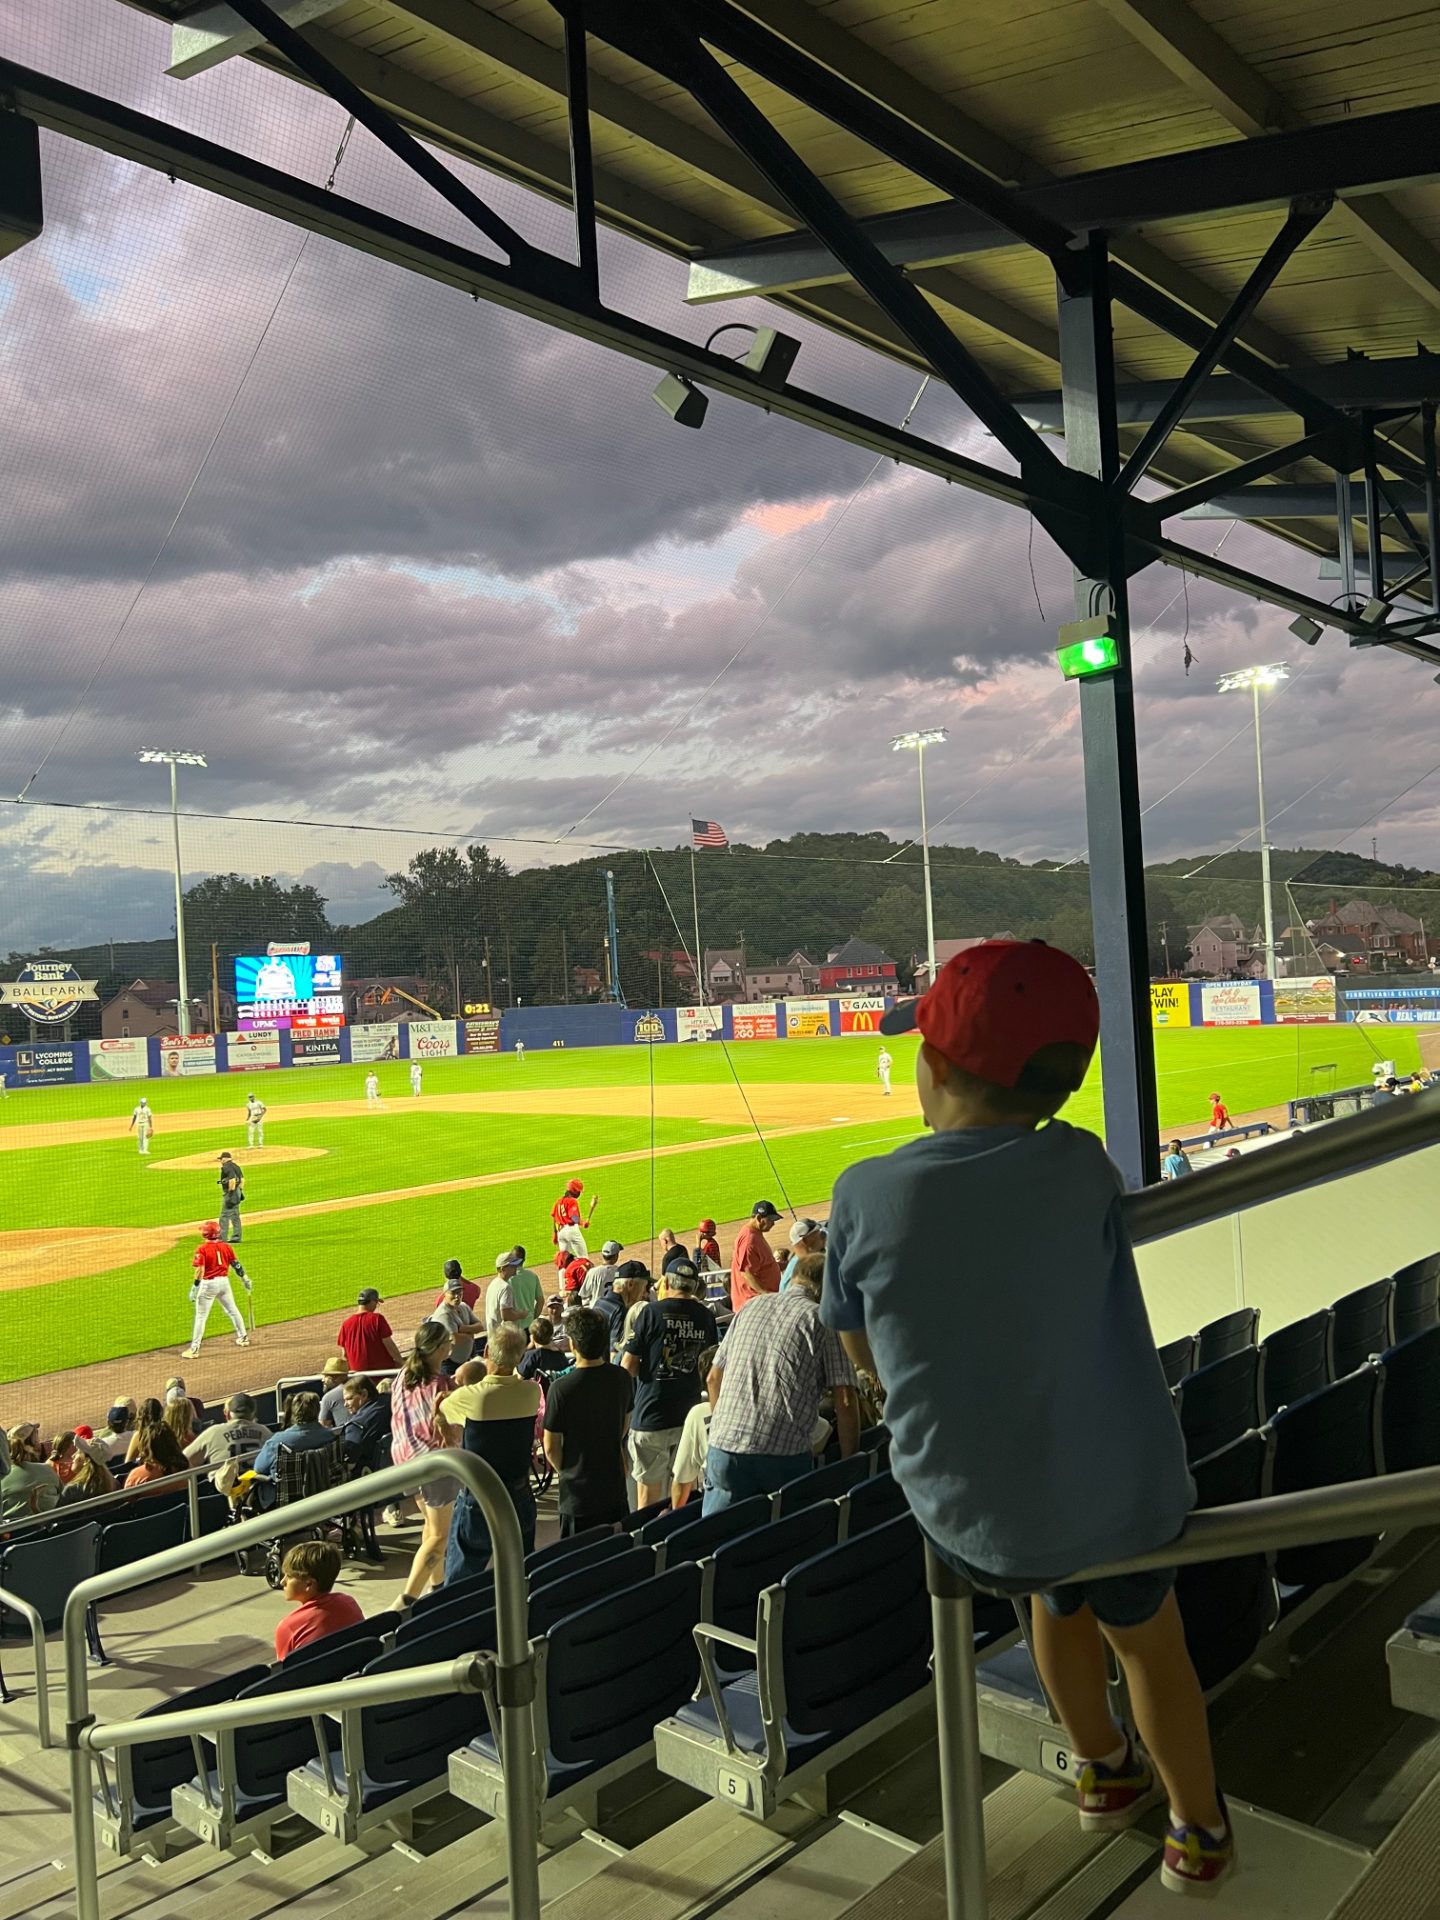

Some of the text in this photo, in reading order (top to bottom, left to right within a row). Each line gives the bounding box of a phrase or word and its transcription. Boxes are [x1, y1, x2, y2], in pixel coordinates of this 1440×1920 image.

[25, 963, 72, 973] Journey
[33, 971, 65, 981] Bank
[12, 985, 86, 997] BALLPARK
[852, 1001, 883, 1010] GAVL
[1154, 998, 1179, 1008] WIN!
[464, 1003, 490, 1014] 0:21
[253, 1020, 277, 1028] UPMC
[410, 1023, 432, 1033] M&T
[639, 1023, 659, 1032] 100
[249, 1031, 272, 1039] LUNDY
[292, 1028, 336, 1038] FRED HAMM
[305, 1043, 338, 1052] KINTRA
[416, 1036, 450, 1049] Coors
[35, 1051, 73, 1059] LYCOMING
[421, 1049, 447, 1057] LIGHT
[39, 1057, 73, 1066] COLLEGE
[666, 1319, 694, 1330] RAH!
[678, 1329, 705, 1340] RAH!
[1056, 1751, 1068, 1771] 6
[727, 1777, 736, 1795] 5
[325, 1813, 331, 1827] 3
[203, 1824, 208, 1836] 2
